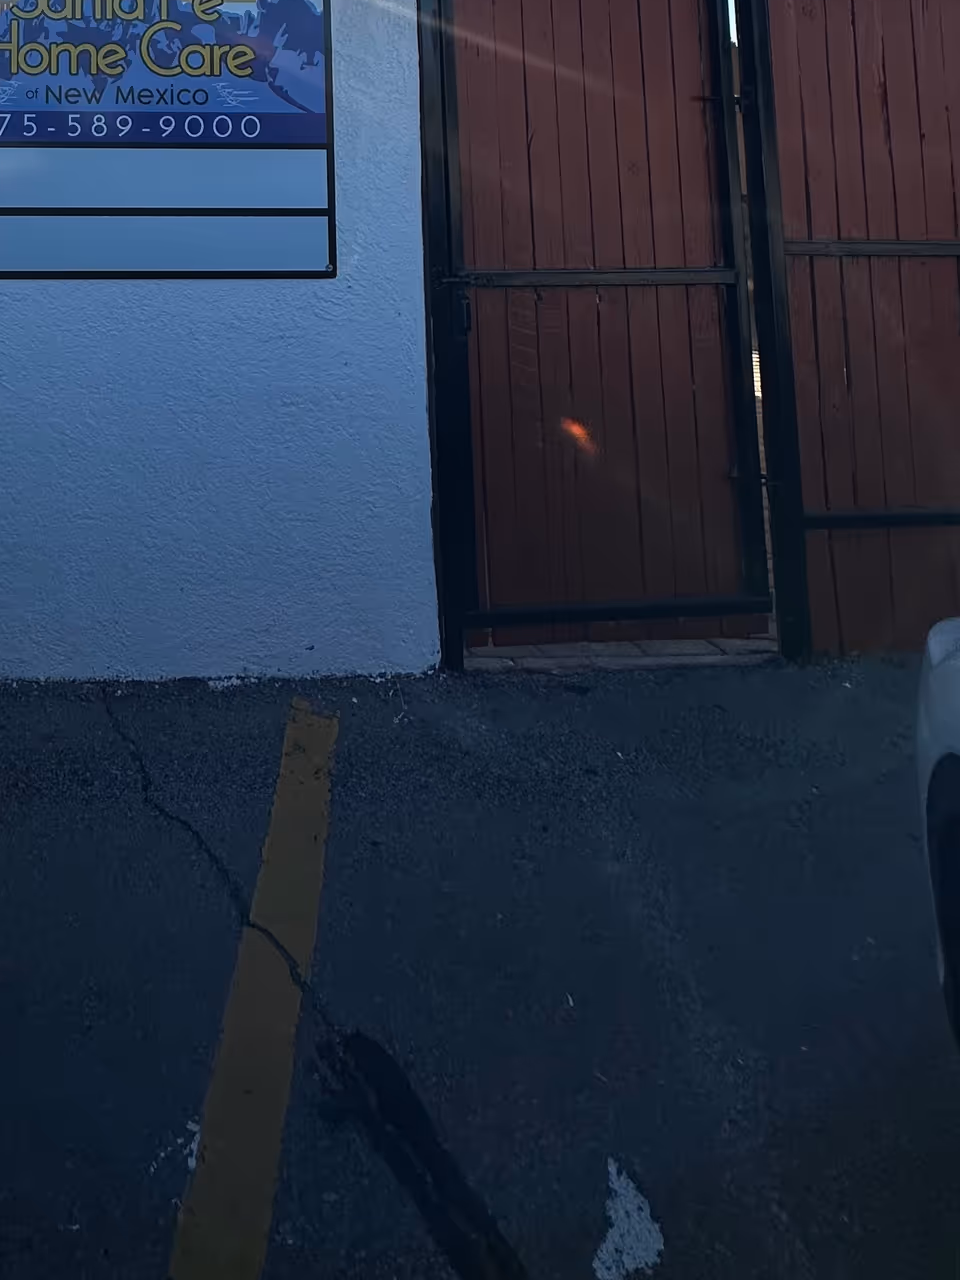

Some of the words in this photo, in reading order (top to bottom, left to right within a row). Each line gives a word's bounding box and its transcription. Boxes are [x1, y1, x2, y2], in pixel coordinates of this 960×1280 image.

[139, 21, 256, 78] Care
[25, 87, 39, 100] of
[44, 84, 105, 105] New
[114, 85, 209, 106] Mexico
